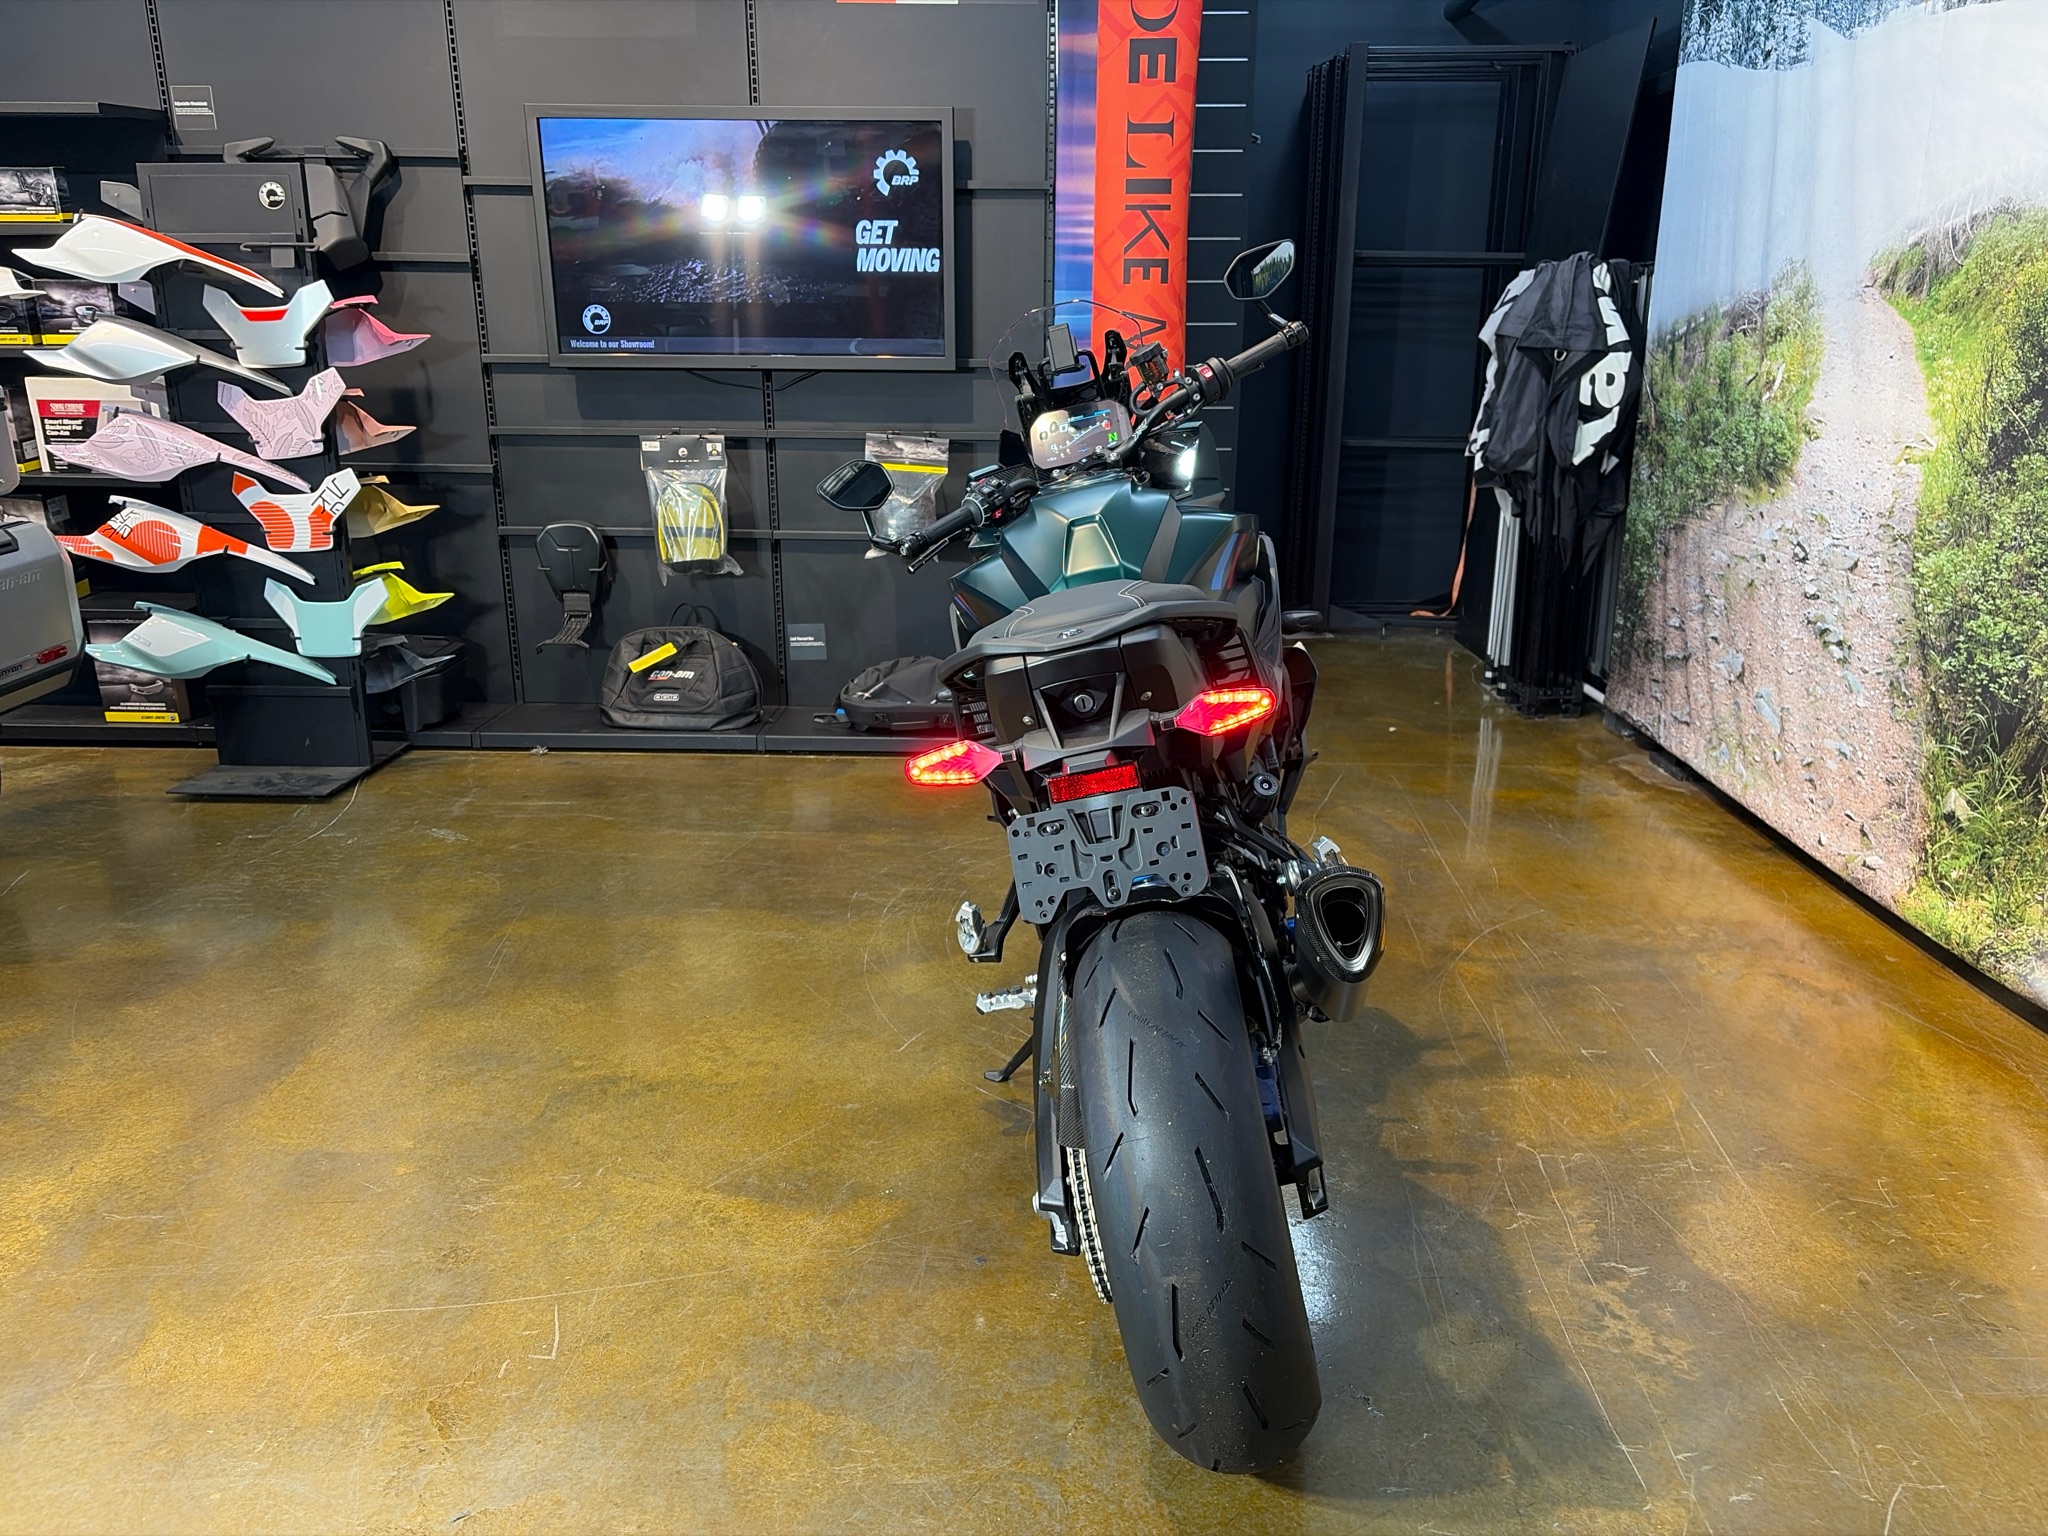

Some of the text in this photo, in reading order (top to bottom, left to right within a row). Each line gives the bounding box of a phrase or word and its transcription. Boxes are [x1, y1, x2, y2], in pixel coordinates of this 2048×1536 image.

[891, 175, 919, 186] BRP
[1123, 112, 1175, 286] LIKE
[855, 219, 899, 245] GET
[856, 247, 941, 273] MOVING
[570, 339, 599, 348] Welcome
[600, 339, 608, 348] to
[620, 339, 655, 349] Showroom!
[1107, 431, 1119, 443] N
[649, 670, 695, 679] can-am
[653, 693, 680, 702] OGIO
